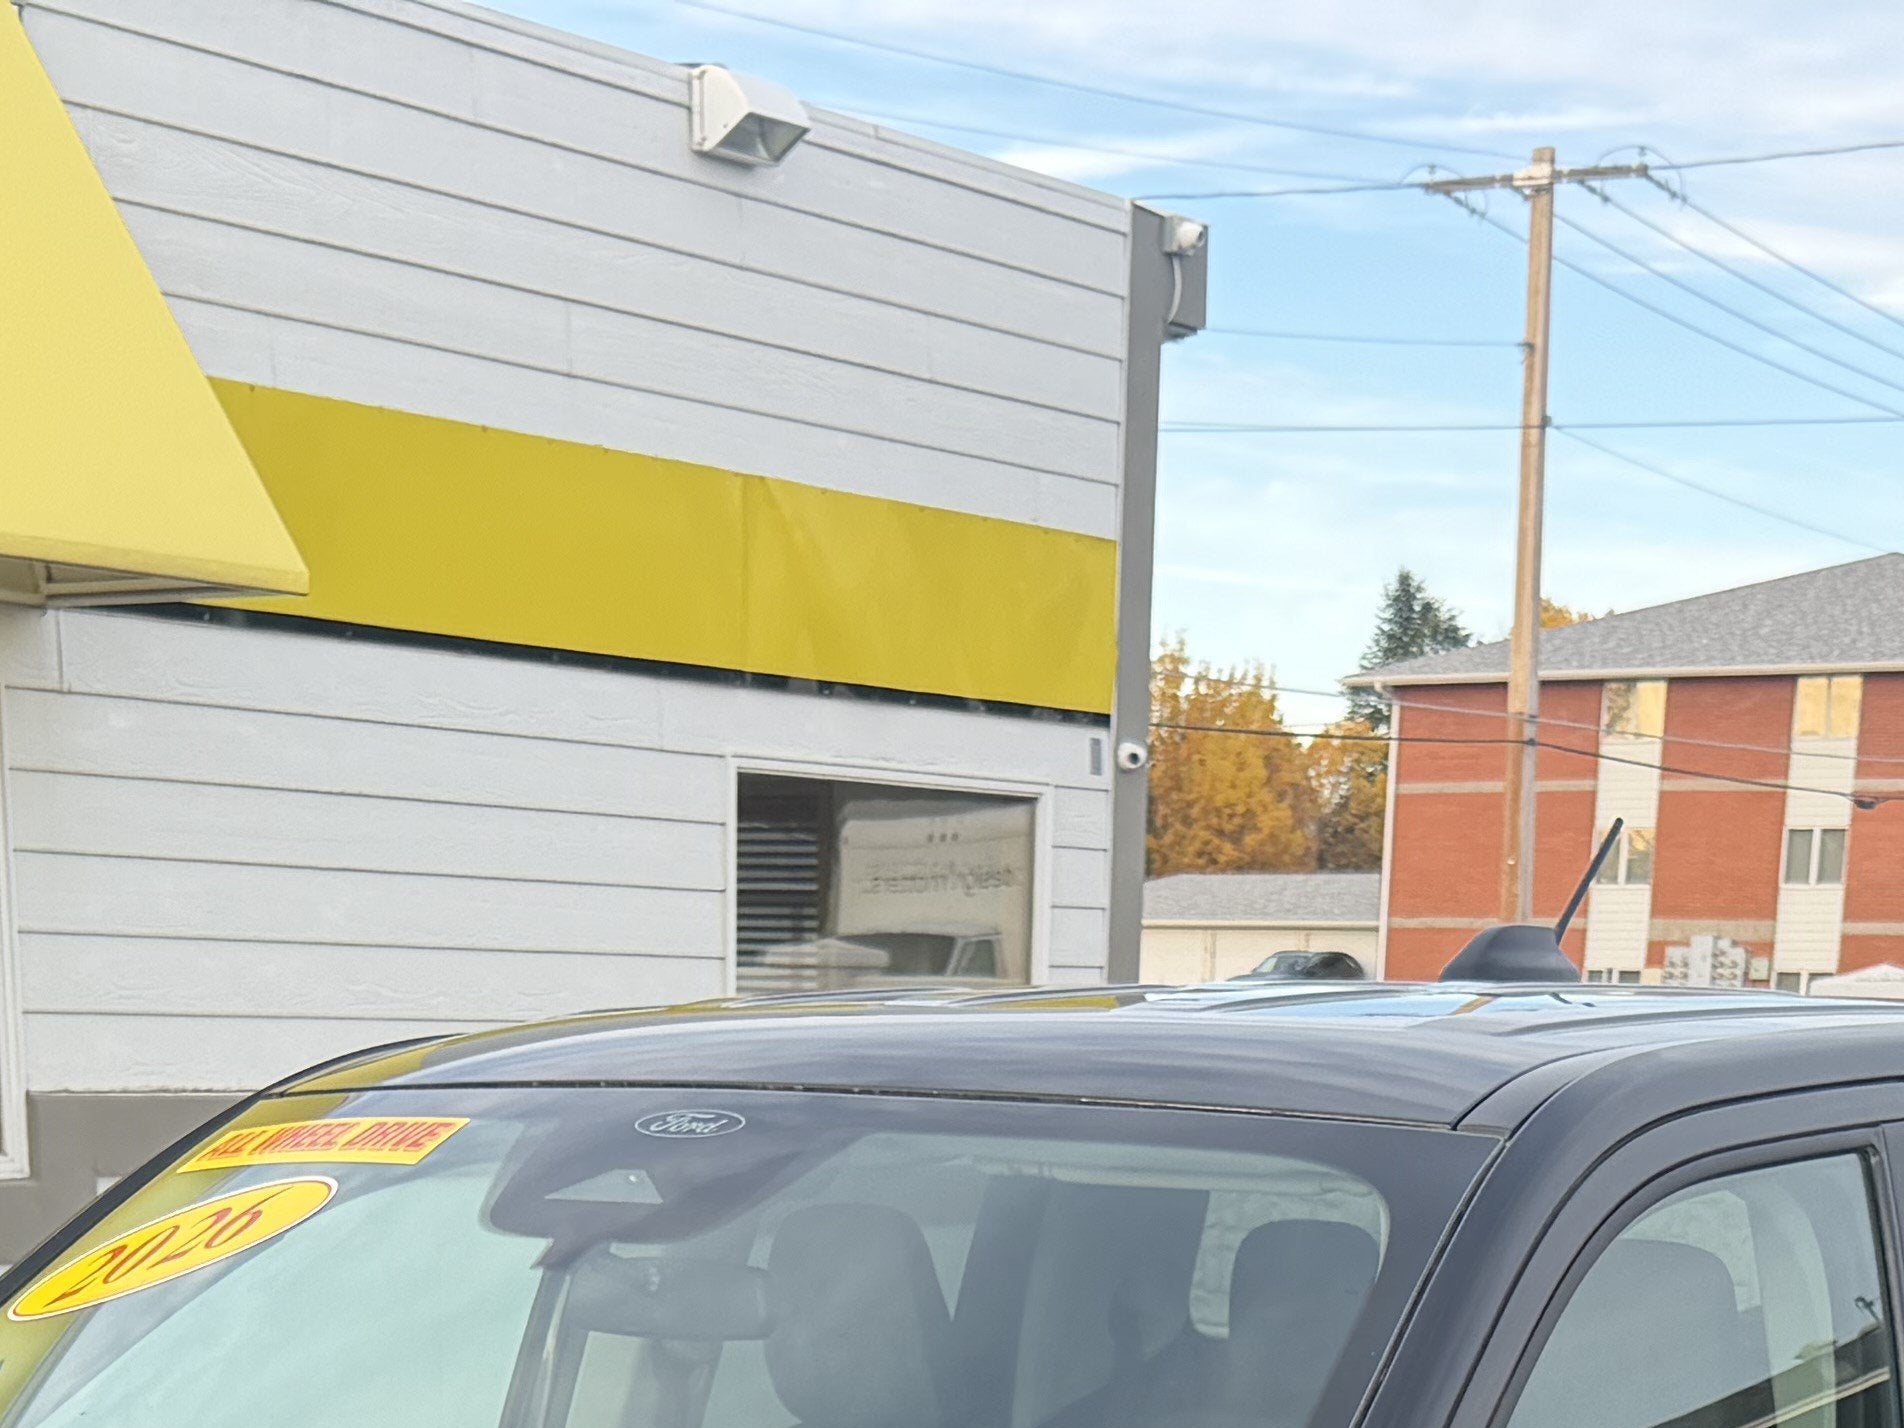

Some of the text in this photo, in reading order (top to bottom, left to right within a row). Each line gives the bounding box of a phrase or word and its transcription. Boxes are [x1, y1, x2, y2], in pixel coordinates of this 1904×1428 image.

[196, 1121, 458, 1161] ALL WHEEL DRIVE
[649, 1111, 729, 1134] Ford
[43, 1187, 295, 1308] 2026
